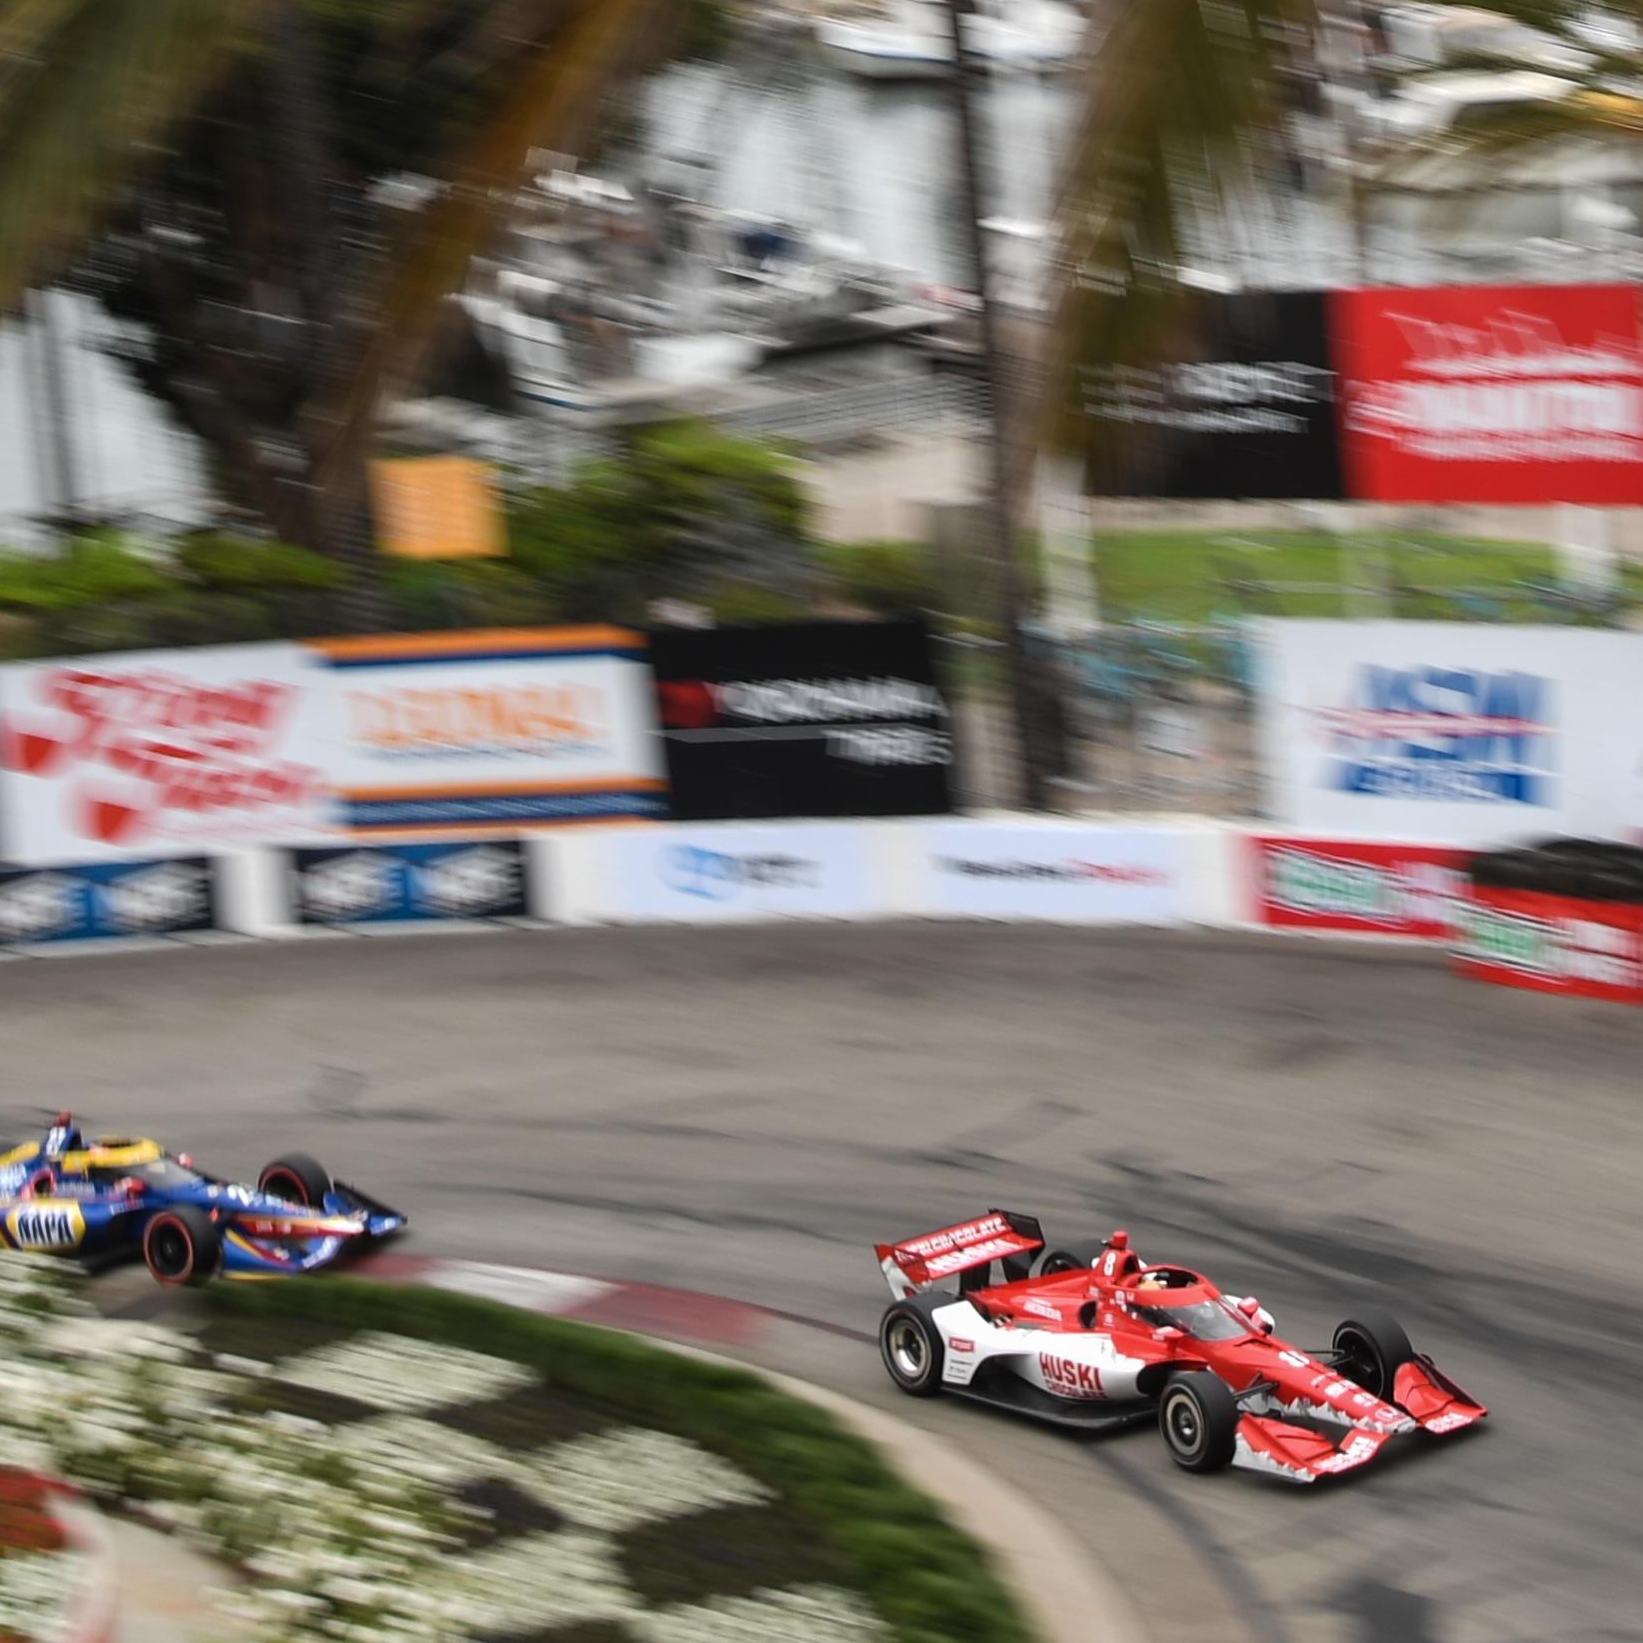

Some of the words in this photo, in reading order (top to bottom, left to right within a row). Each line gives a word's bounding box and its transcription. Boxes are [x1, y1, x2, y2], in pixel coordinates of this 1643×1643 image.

[17, 1205, 74, 1246] NAPA
[1103, 1252, 1116, 1276] 8
[1039, 1351, 1104, 1391] HUSKI
